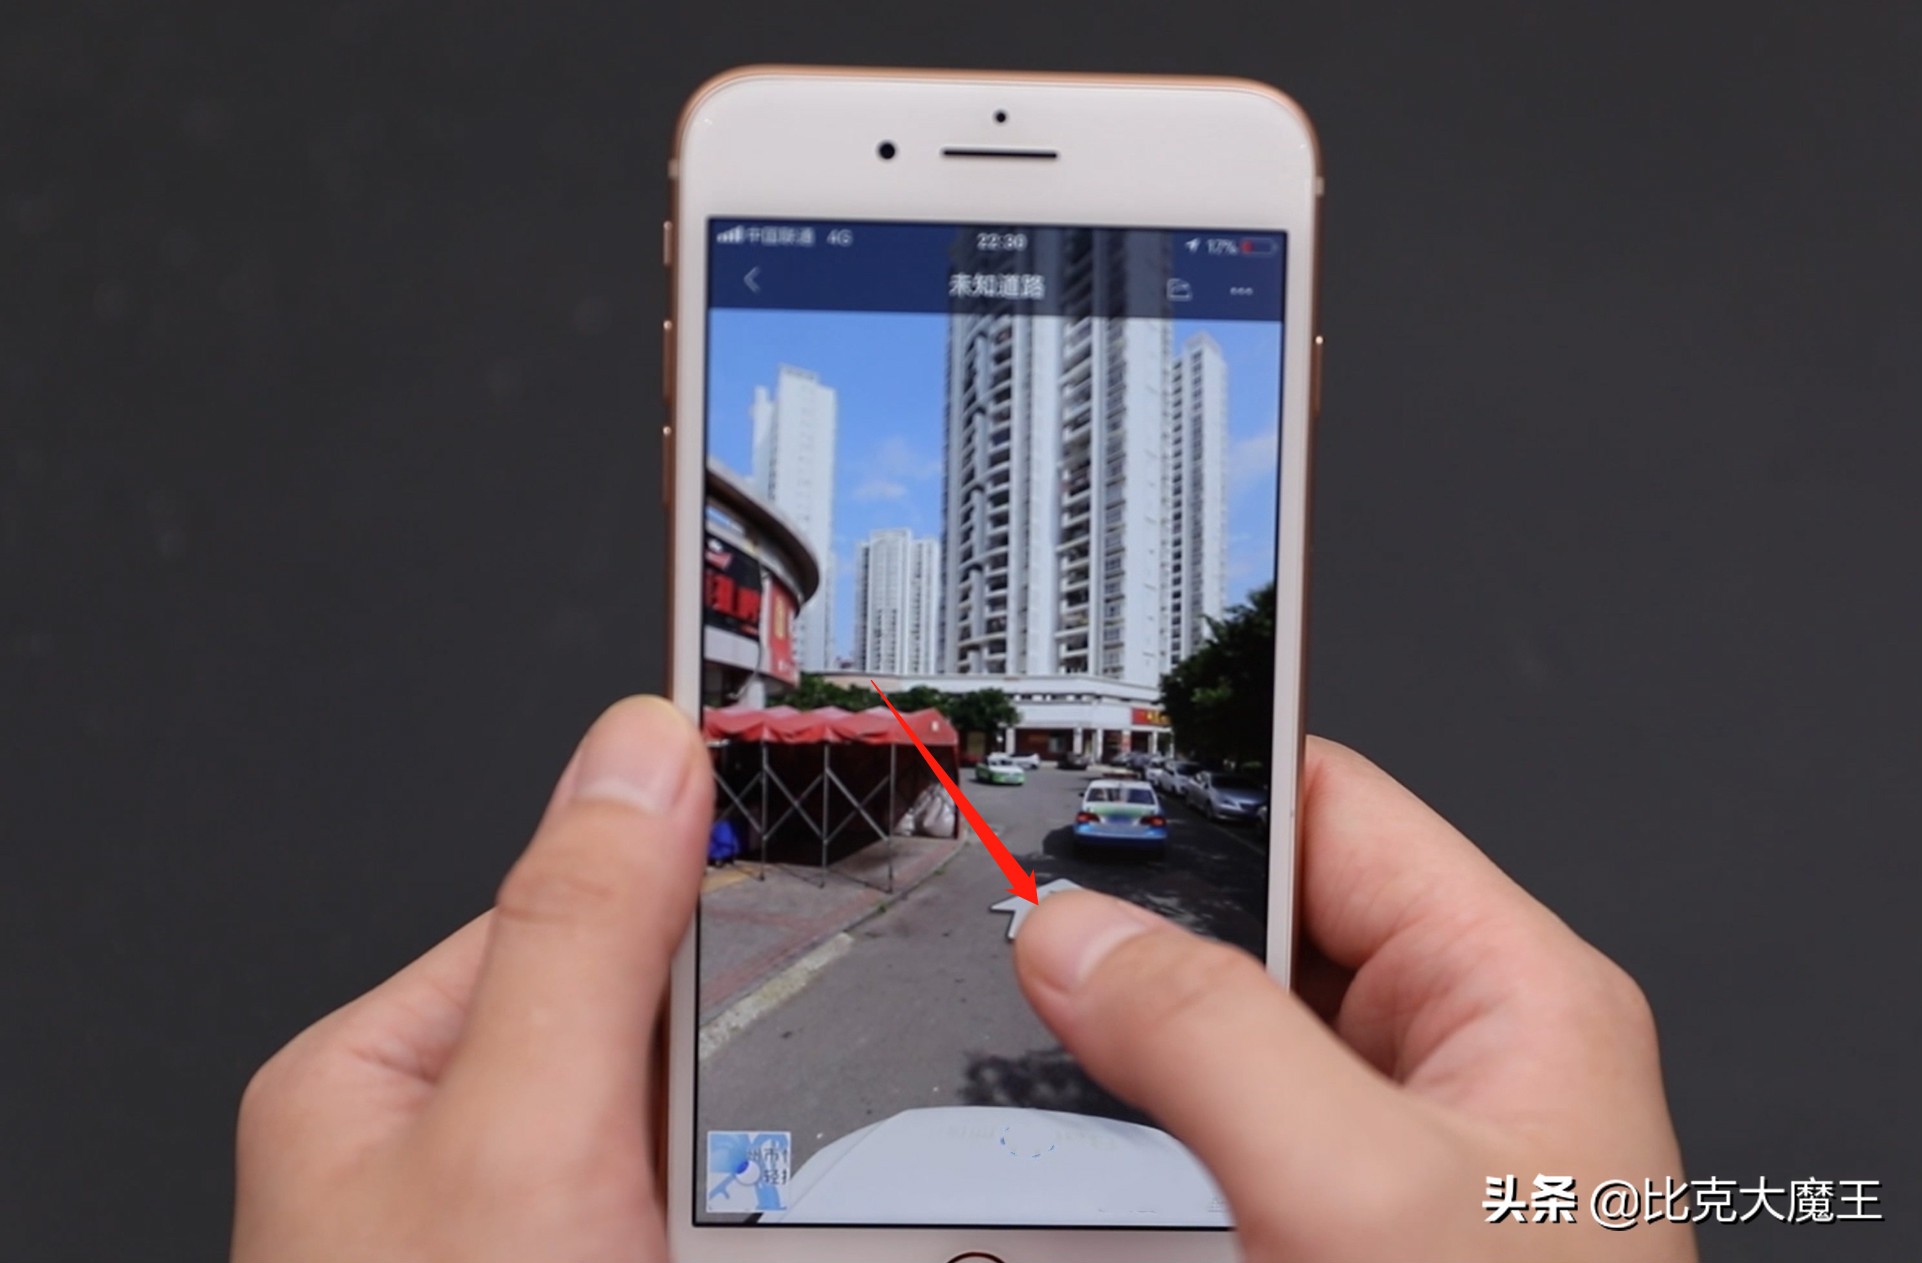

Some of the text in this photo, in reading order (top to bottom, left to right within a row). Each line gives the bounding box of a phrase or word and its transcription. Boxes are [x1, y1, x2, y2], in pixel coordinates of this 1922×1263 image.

[827, 229, 853, 247] 4G
[949, 273, 1045, 300] 未知道路
